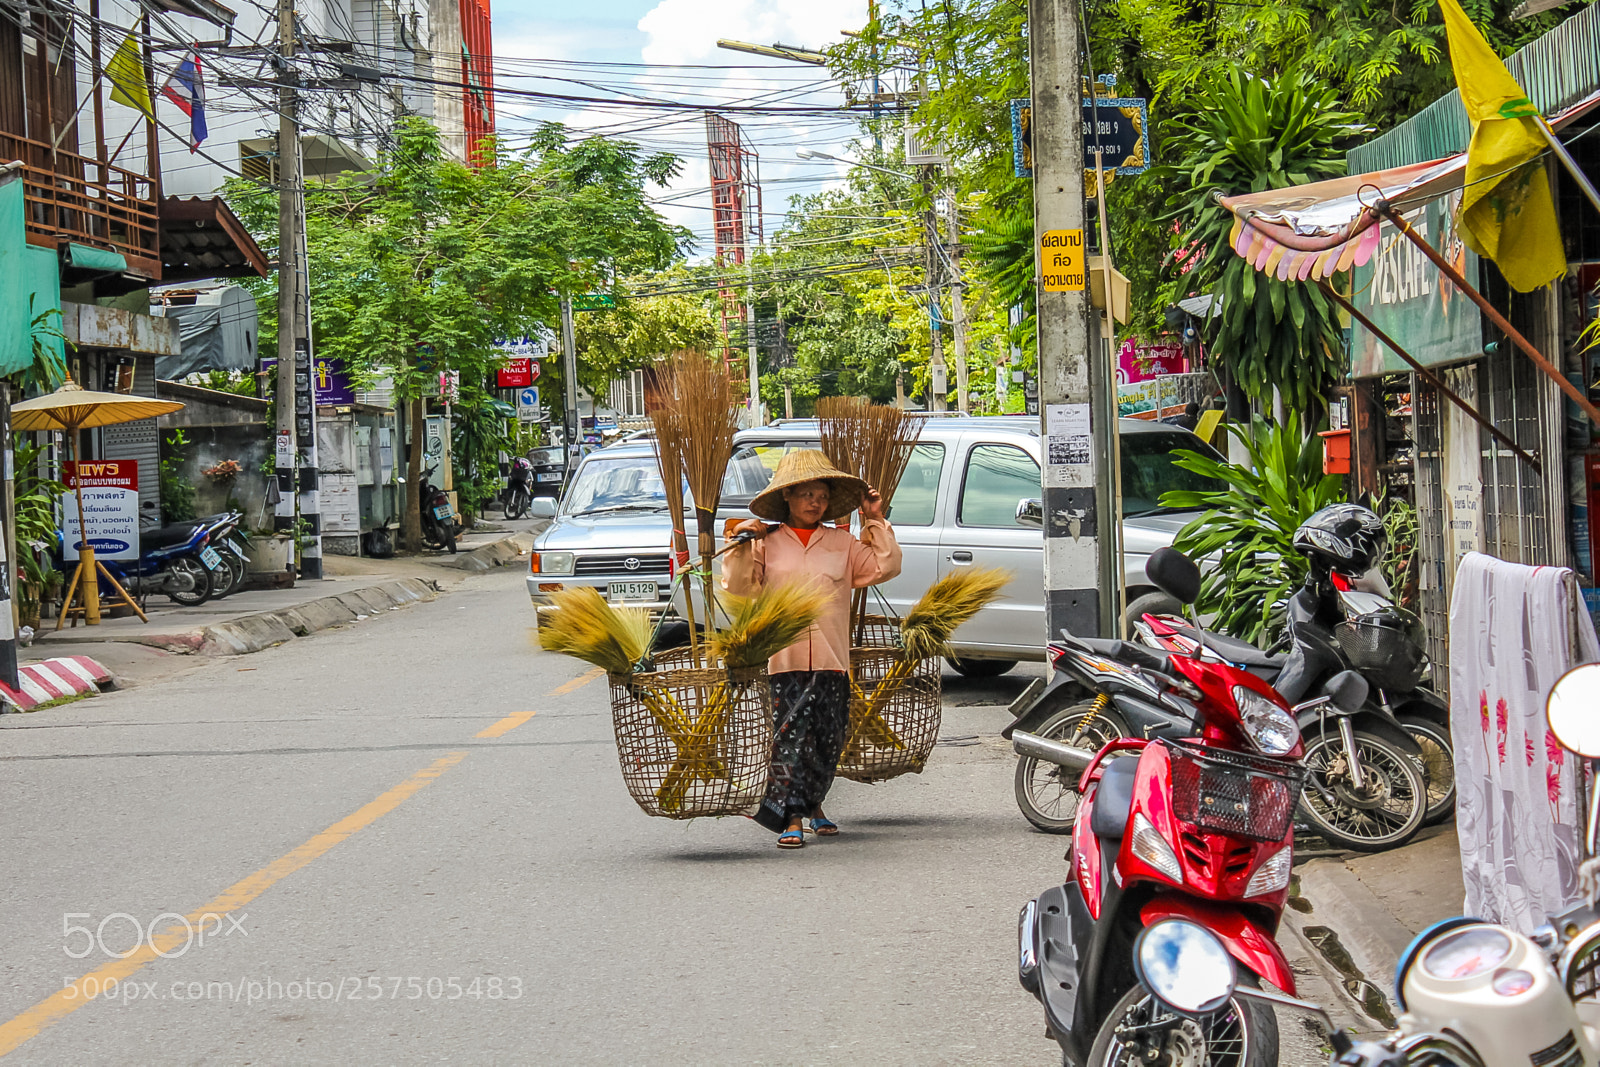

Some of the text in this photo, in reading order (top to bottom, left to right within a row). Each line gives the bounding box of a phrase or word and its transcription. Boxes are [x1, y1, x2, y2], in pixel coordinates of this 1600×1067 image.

[1113, 121, 1119, 134] 9
[1105, 145, 1116, 154] SOI
[1116, 145, 1121, 154] 9
[1041, 231, 1081, 247] ผลบาป
[1053, 253, 1072, 267] คือ
[1043, 274, 1083, 286] ความตาย
[1117, 391, 1145, 405] ungle
[79, 463, 119, 477] แพร
[629, 583, 654, 594] 5129
